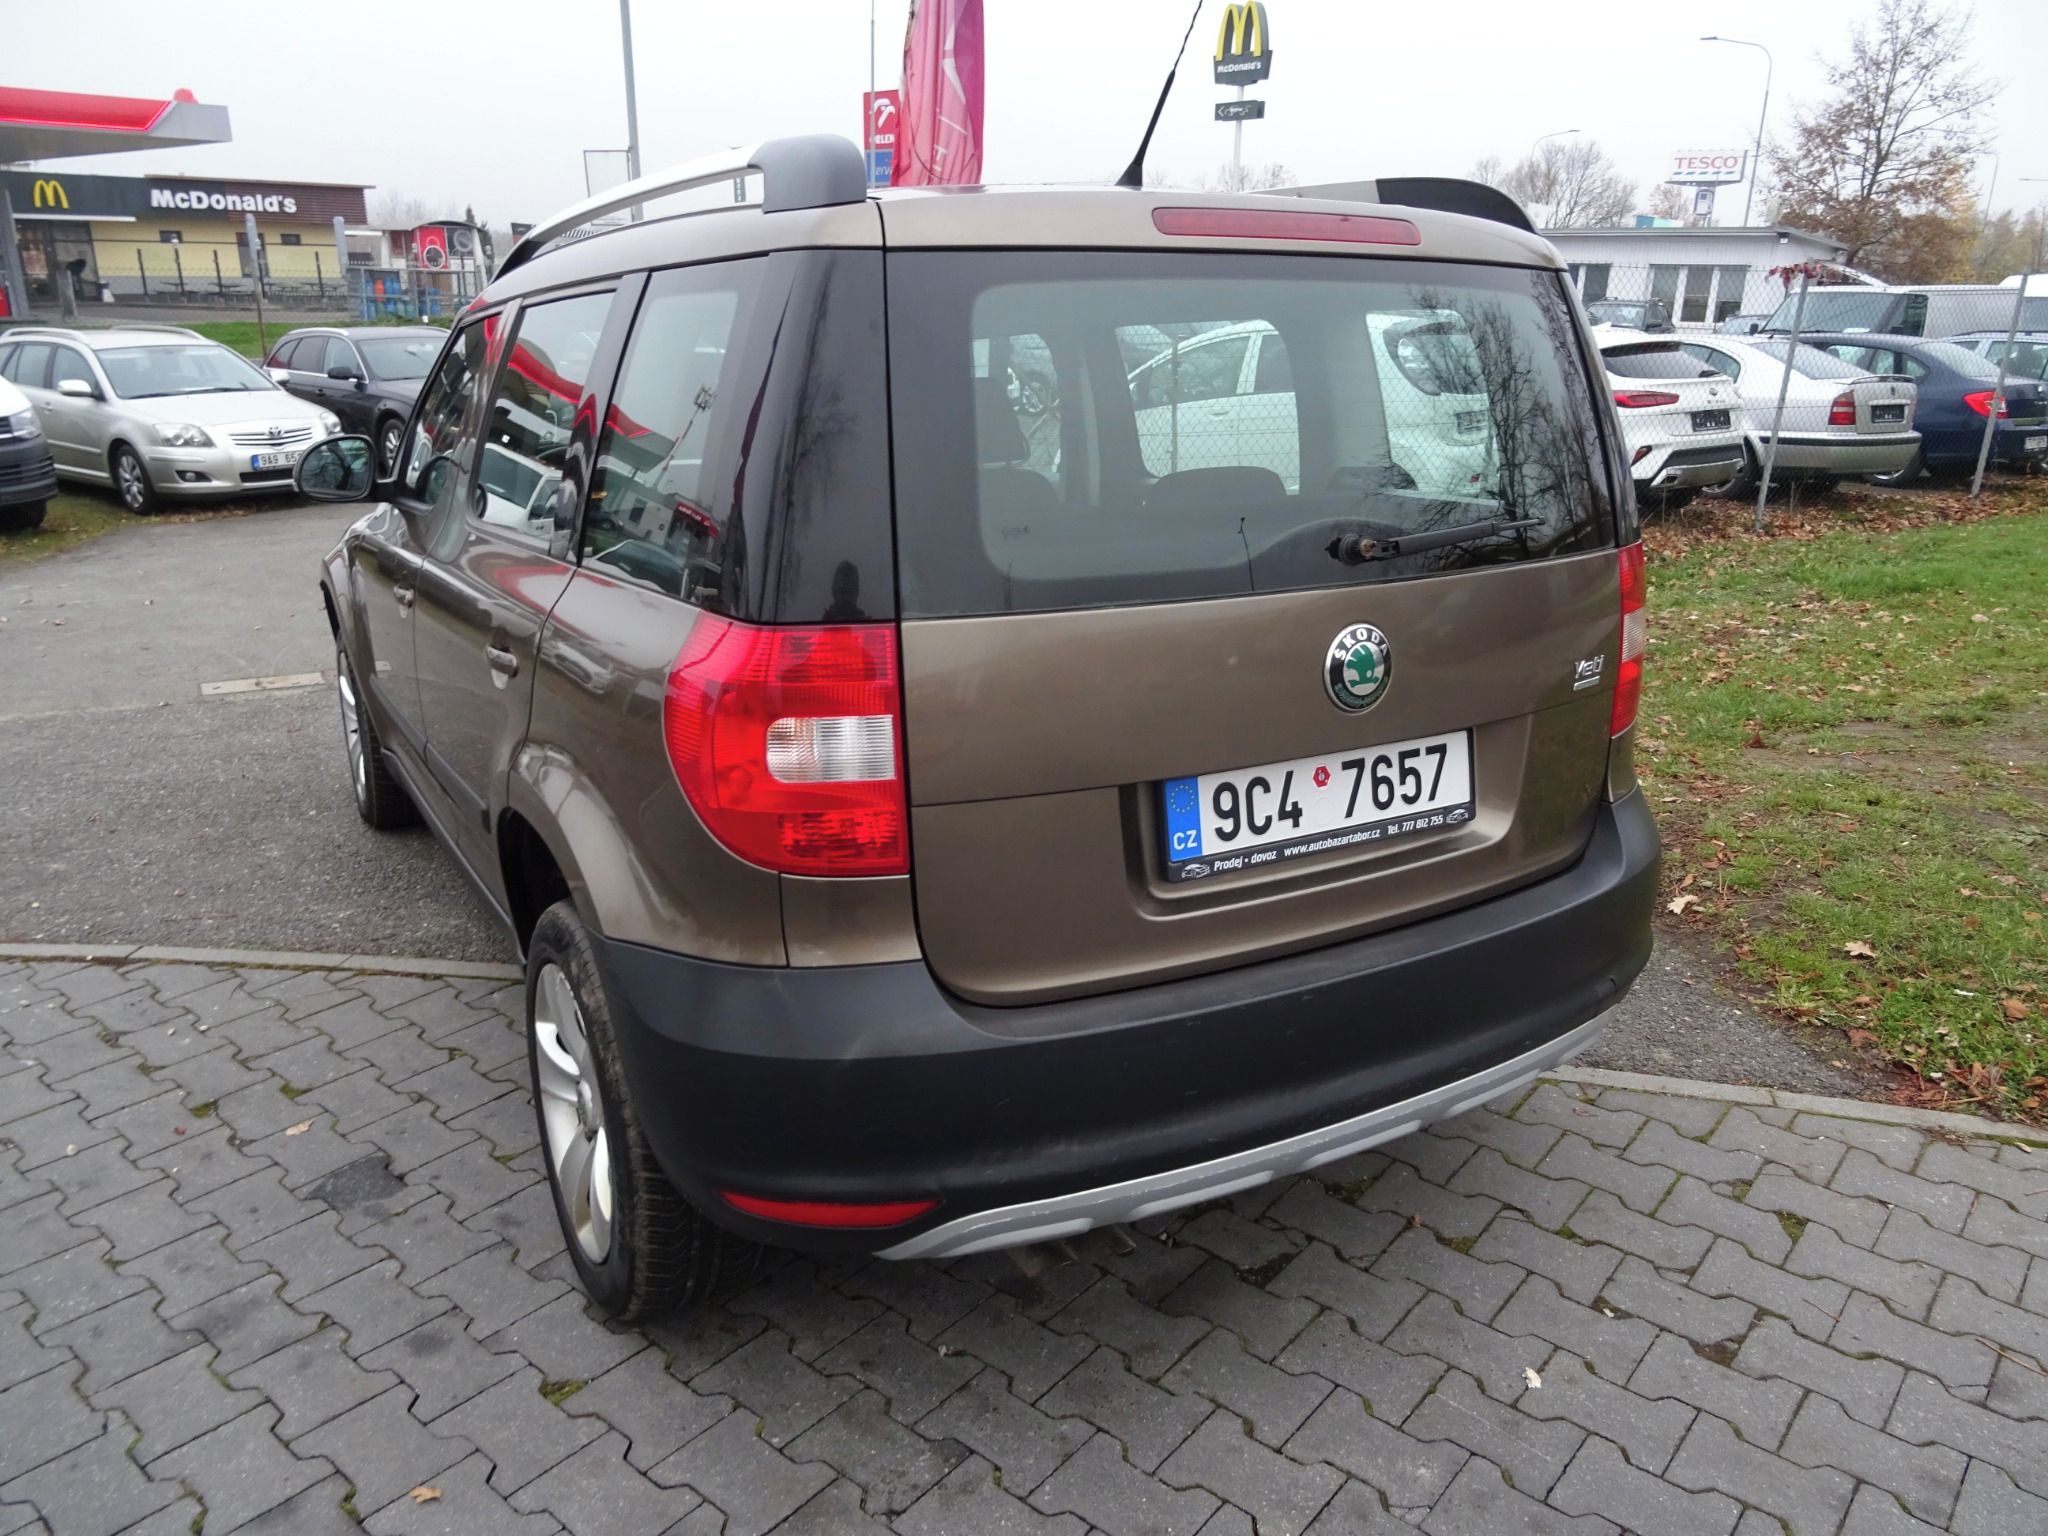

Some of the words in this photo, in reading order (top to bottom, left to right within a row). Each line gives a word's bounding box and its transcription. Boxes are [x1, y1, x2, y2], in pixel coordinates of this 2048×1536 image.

[1216, 61, 1262, 74] McDonald's
[1674, 155, 1739, 170] TESCO
[150, 187, 298, 214] McDonald's
[1574, 654, 1606, 679] Yeti
[1212, 769, 1303, 842] 9C4
[1341, 743, 1448, 819] 7657
[1173, 829, 1198, 851] CZ
[1213, 857, 1243, 872] Prodej
[1250, 850, 1278, 864] dovoz
[1283, 829, 1381, 857] www.autobazartabor.cz
[1386, 822, 1400, 834] Tel.
[1401, 820, 1415, 832] 777
[1415, 817, 1430, 829] 812
[1429, 814, 1444, 826] 755
